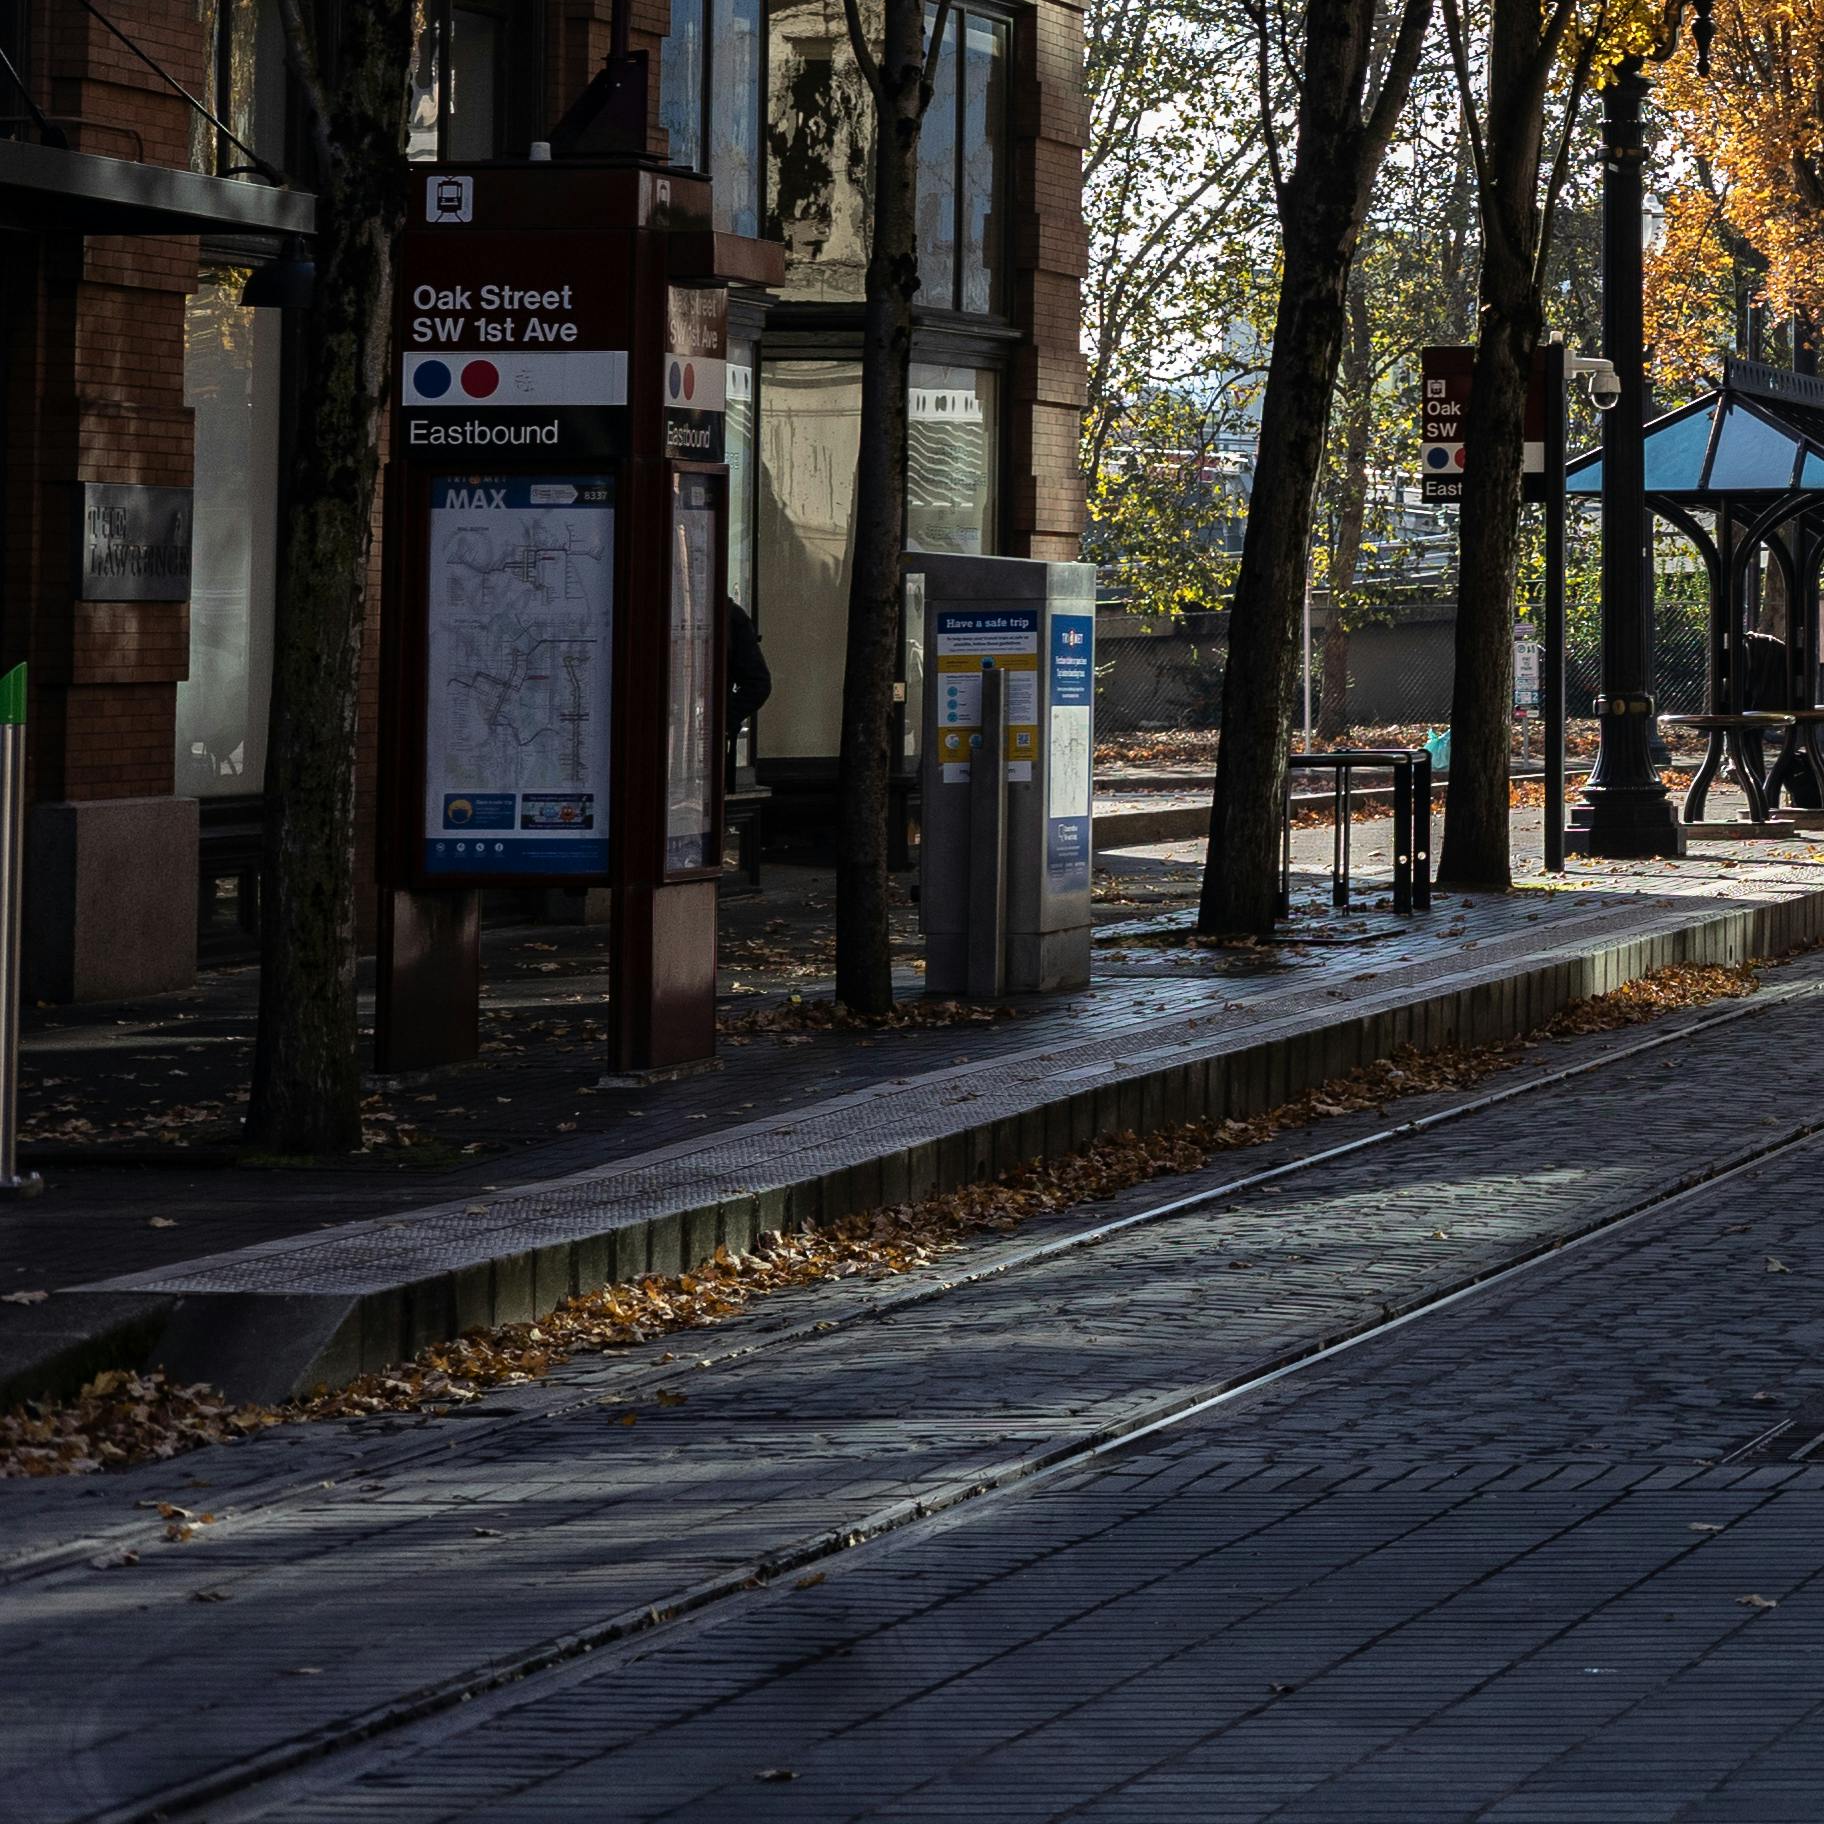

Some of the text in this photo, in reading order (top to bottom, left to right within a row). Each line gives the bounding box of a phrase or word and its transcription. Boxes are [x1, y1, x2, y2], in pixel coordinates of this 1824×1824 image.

[413, 284, 573, 310] Oak Street
[412, 318, 577, 343] SW 1st Ave
[1427, 401, 1462, 416] Oak
[410, 420, 559, 445] Eastbound
[667, 420, 711, 449] Eastbound
[1426, 422, 1457, 438] SW
[445, 488, 507, 509] MAX
[89, 506, 126, 538] THE
[946, 617, 1030, 629] Have a safe trip
